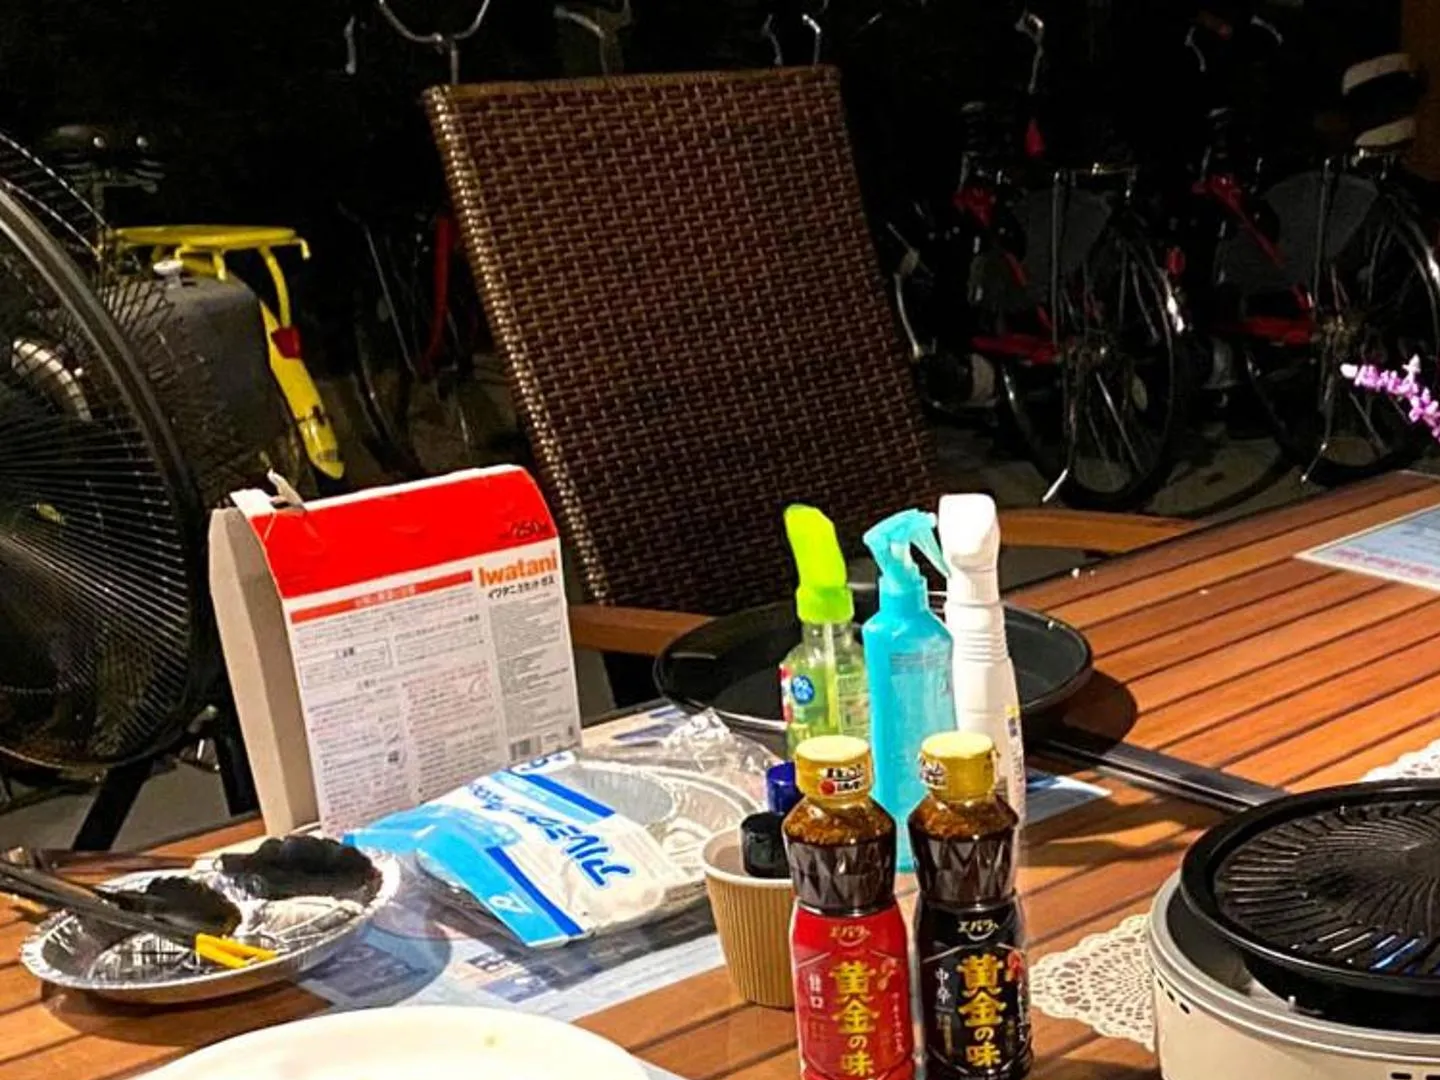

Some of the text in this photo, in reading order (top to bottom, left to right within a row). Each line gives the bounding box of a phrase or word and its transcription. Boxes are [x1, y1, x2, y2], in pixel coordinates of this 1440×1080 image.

[478, 549, 557, 588] Iwatani
[957, 919, 999, 940] エバラ
[828, 960, 880, 1076] 黄金の味
[956, 953, 1007, 1067] 黄金の味
